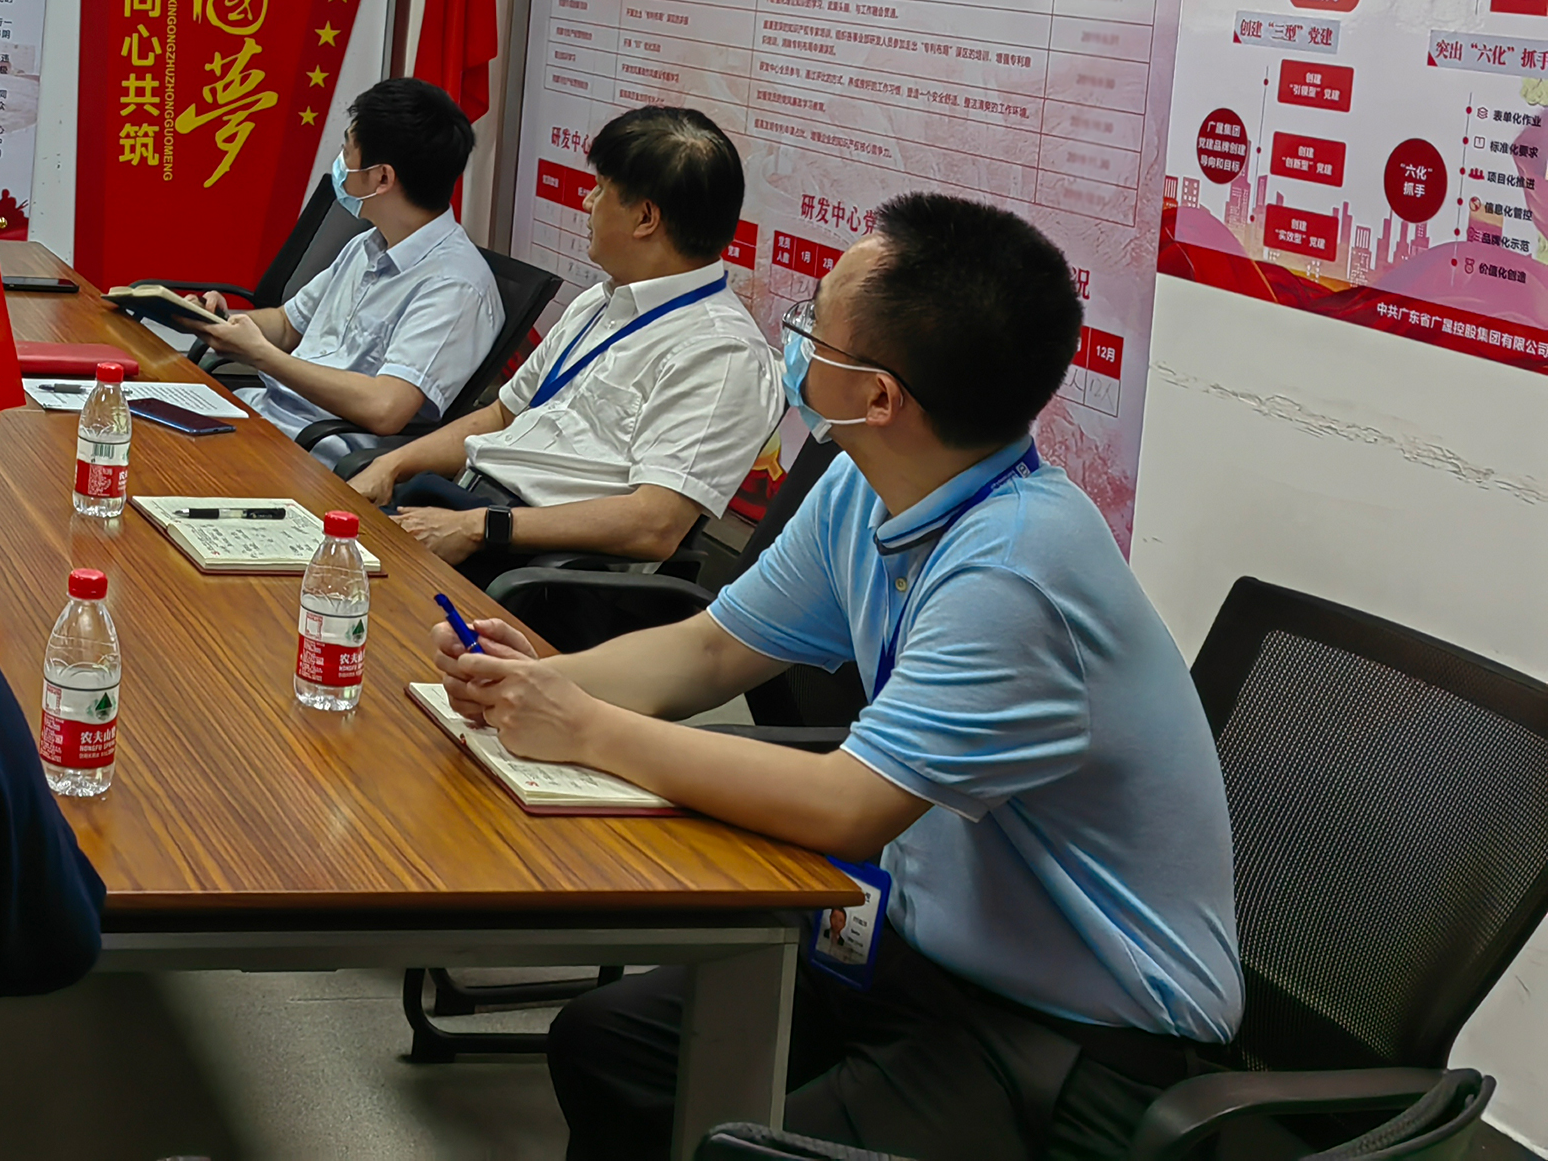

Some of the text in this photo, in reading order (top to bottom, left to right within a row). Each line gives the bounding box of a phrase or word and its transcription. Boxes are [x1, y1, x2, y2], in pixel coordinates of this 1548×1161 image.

[1306, 72, 1321, 84] 创建
[1493, 109, 1542, 127] 表单化作业
[1207, 121, 1240, 137] 广晟集团
[1198, 136, 1246, 156] 党建品牌创建
[1298, 145, 1314, 159] 创建
[1490, 141, 1539, 159] 标准化要求
[1200, 154, 1240, 173] 导向和目标
[1487, 171, 1535, 190] 项目化推进
[1403, 182, 1426, 198] 抓手
[1484, 202, 1533, 221] 信息化管控
[778, 236, 791, 249] 党员
[801, 251, 811, 263] 1月
[823, 258, 834, 270] 2月
[1478, 262, 1527, 284] 价值化创造
[1096, 345, 1115, 363] 12月
